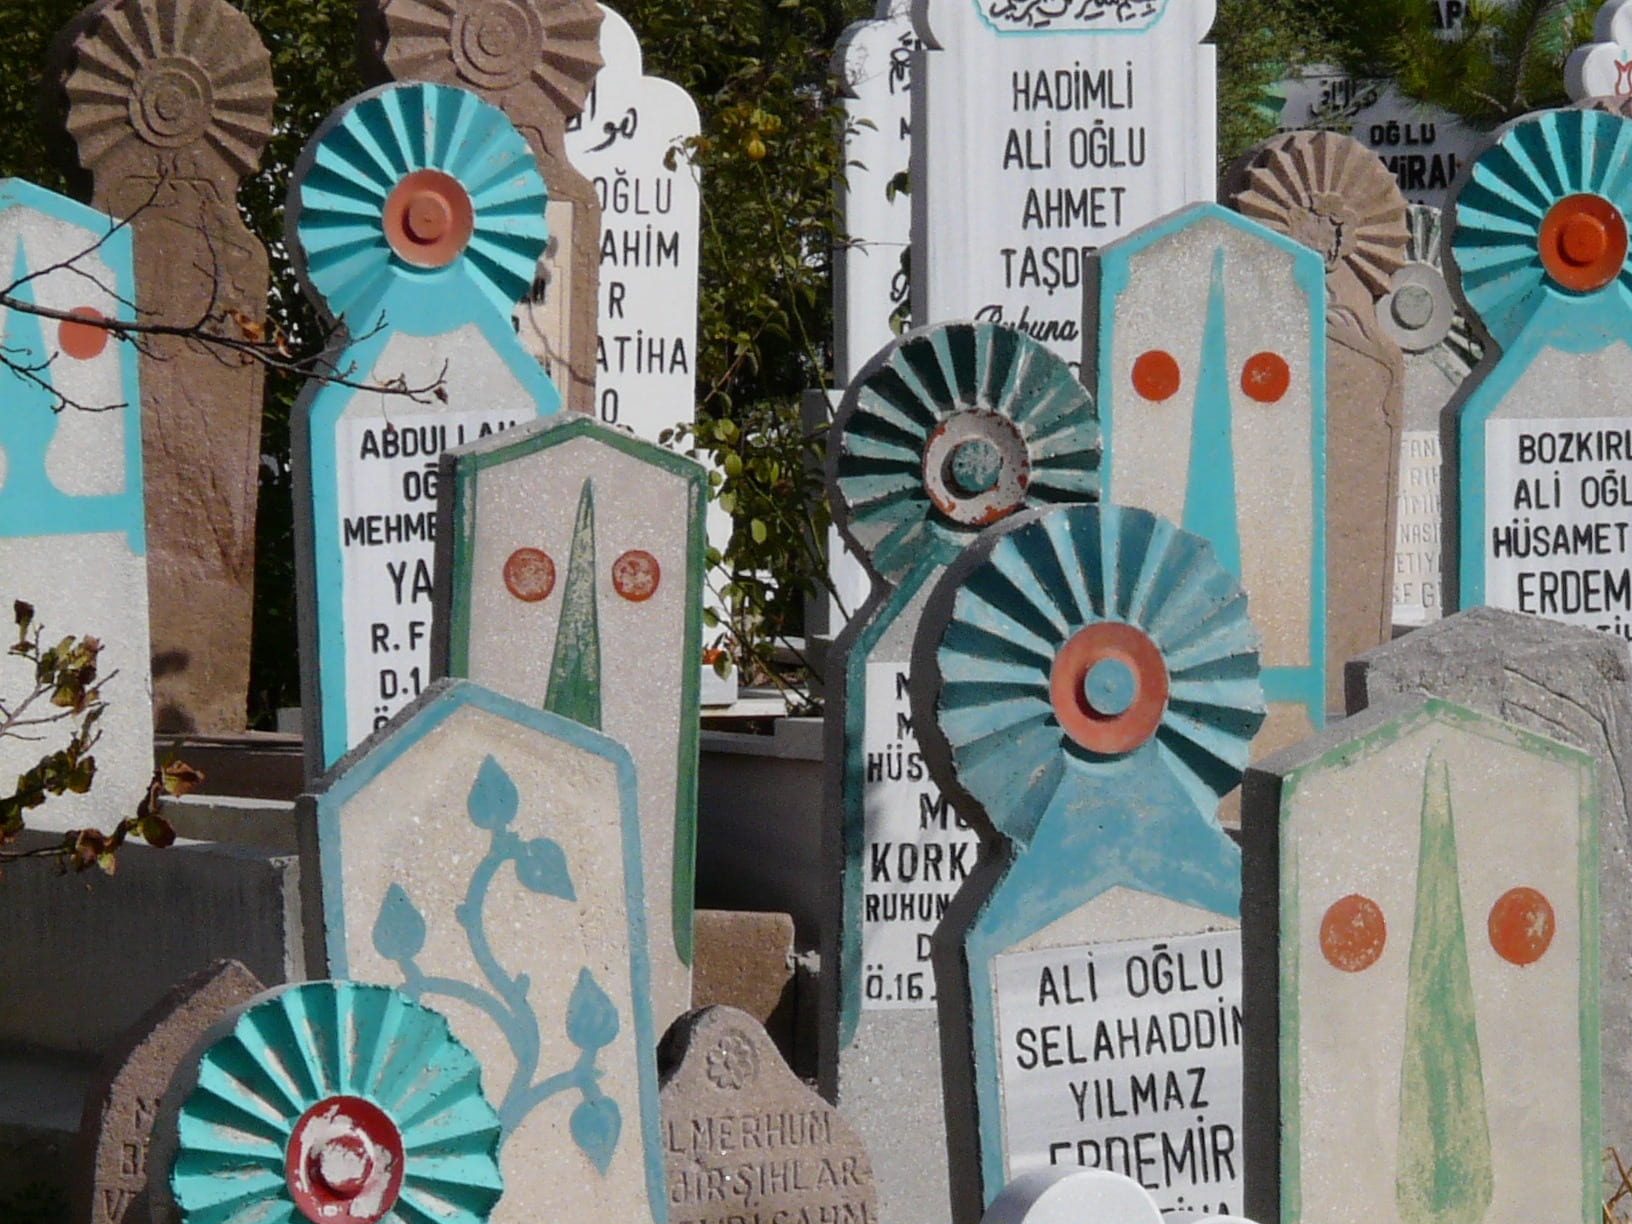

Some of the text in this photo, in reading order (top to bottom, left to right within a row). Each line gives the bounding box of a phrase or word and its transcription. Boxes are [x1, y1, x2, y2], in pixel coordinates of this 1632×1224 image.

[1012, 61, 1133, 112] HADİMLİ
[1003, 120, 1146, 170] ALİ OĞLU
[1022, 187, 1126, 230] AHMET
[1513, 470, 1561, 510] ALİ
[1039, 944, 1223, 1007] ALİ OĞLU
[1069, 1067, 1209, 1122] YILMAZ
